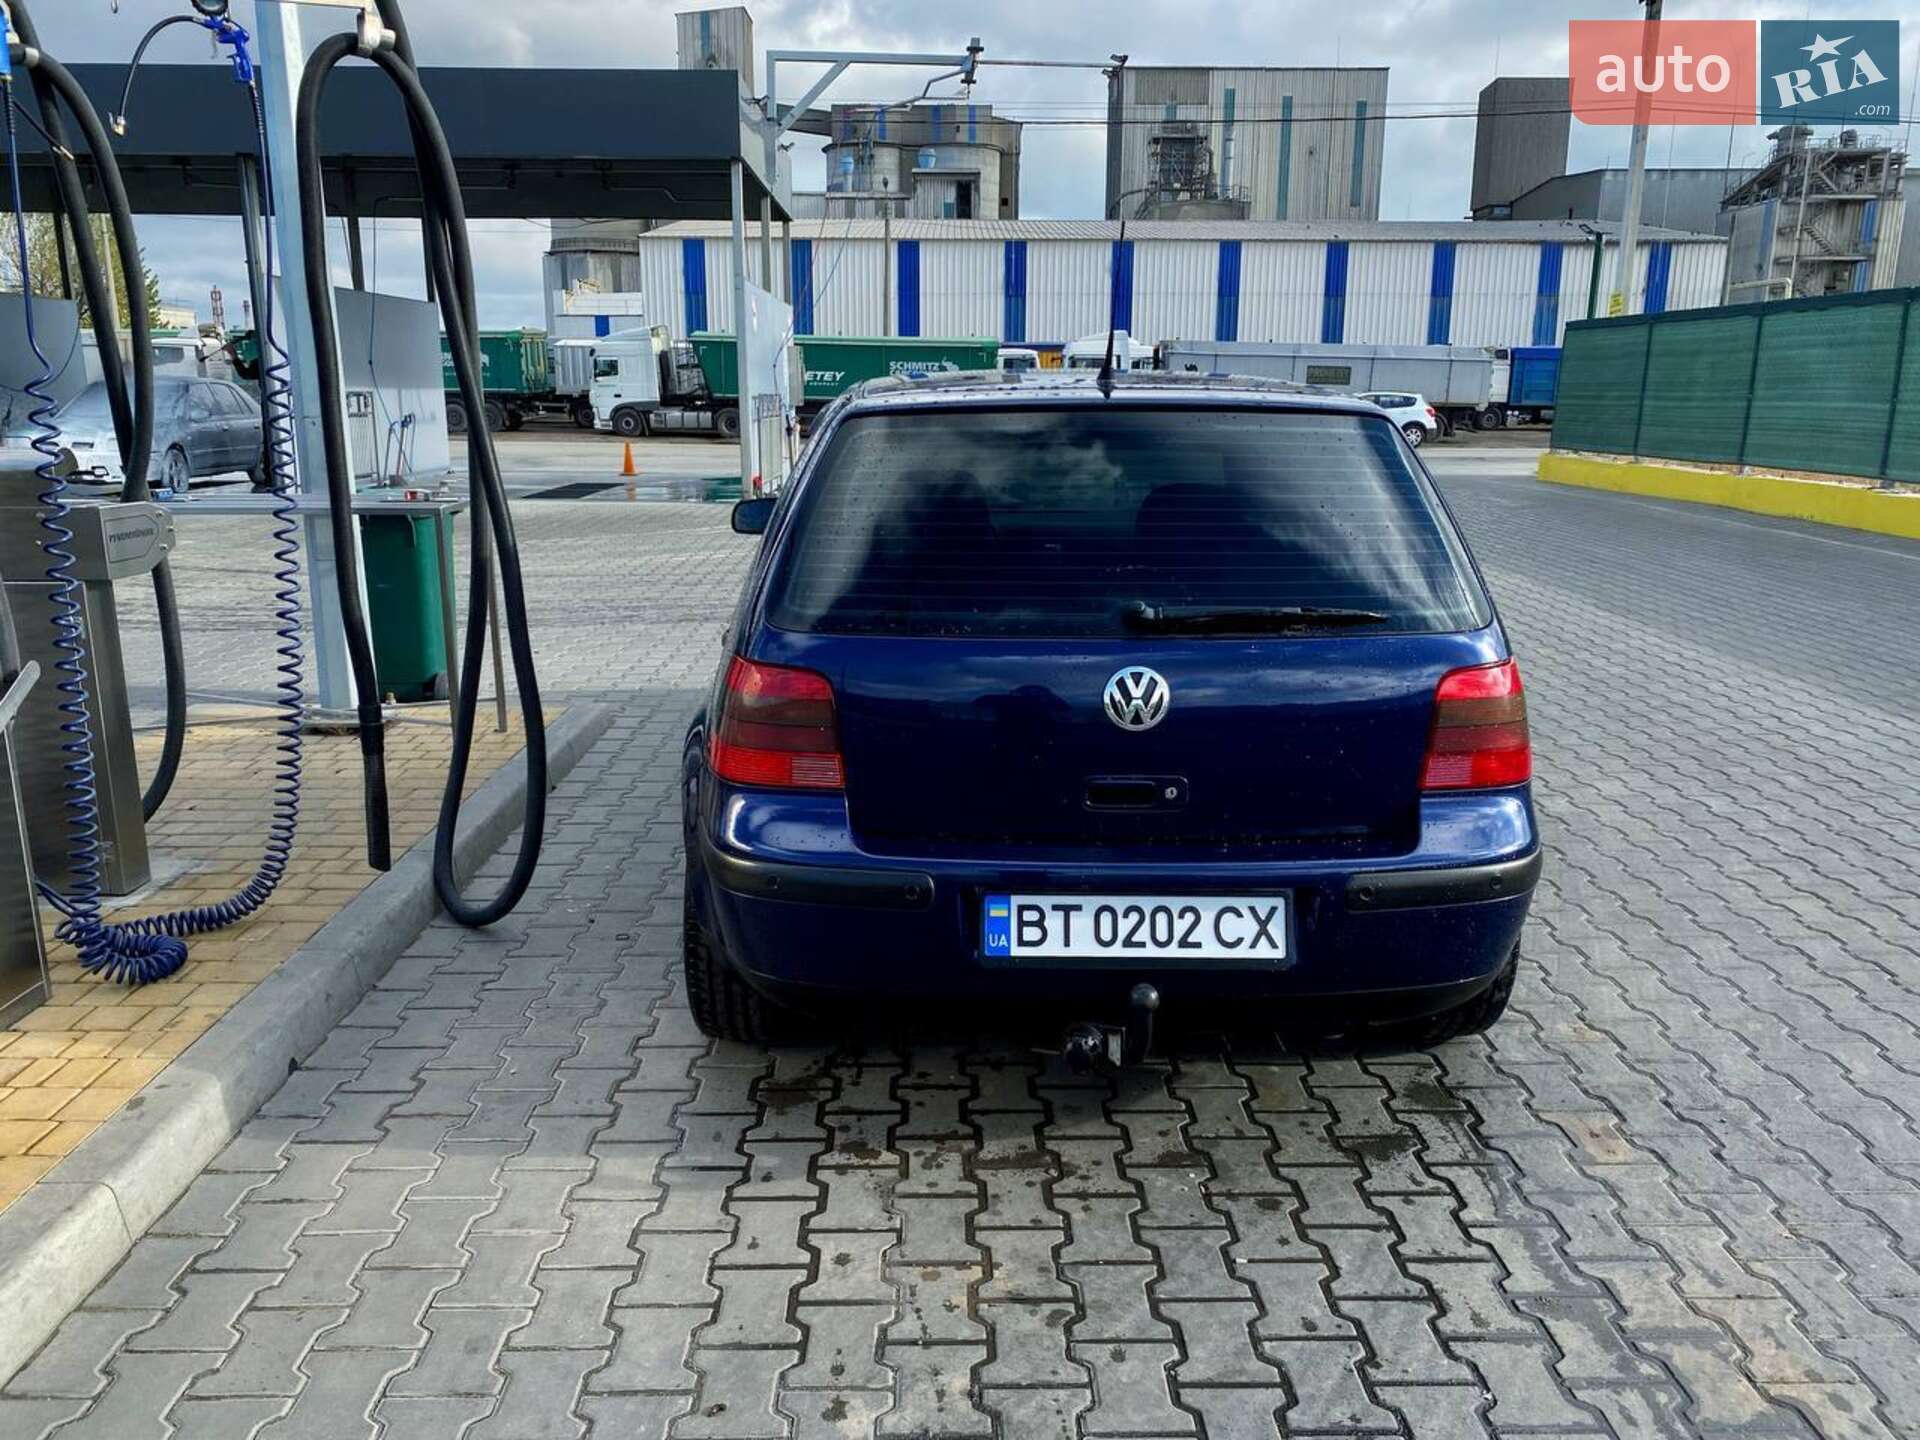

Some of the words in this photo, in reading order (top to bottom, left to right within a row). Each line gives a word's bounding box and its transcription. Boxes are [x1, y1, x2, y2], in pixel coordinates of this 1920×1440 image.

[889, 361, 940, 371] SCHMITZ
[1016, 904, 1083, 948] BT
[1094, 904, 1202, 949] 0202
[1213, 905, 1279, 949] CX
[990, 934, 1008, 948] UA
